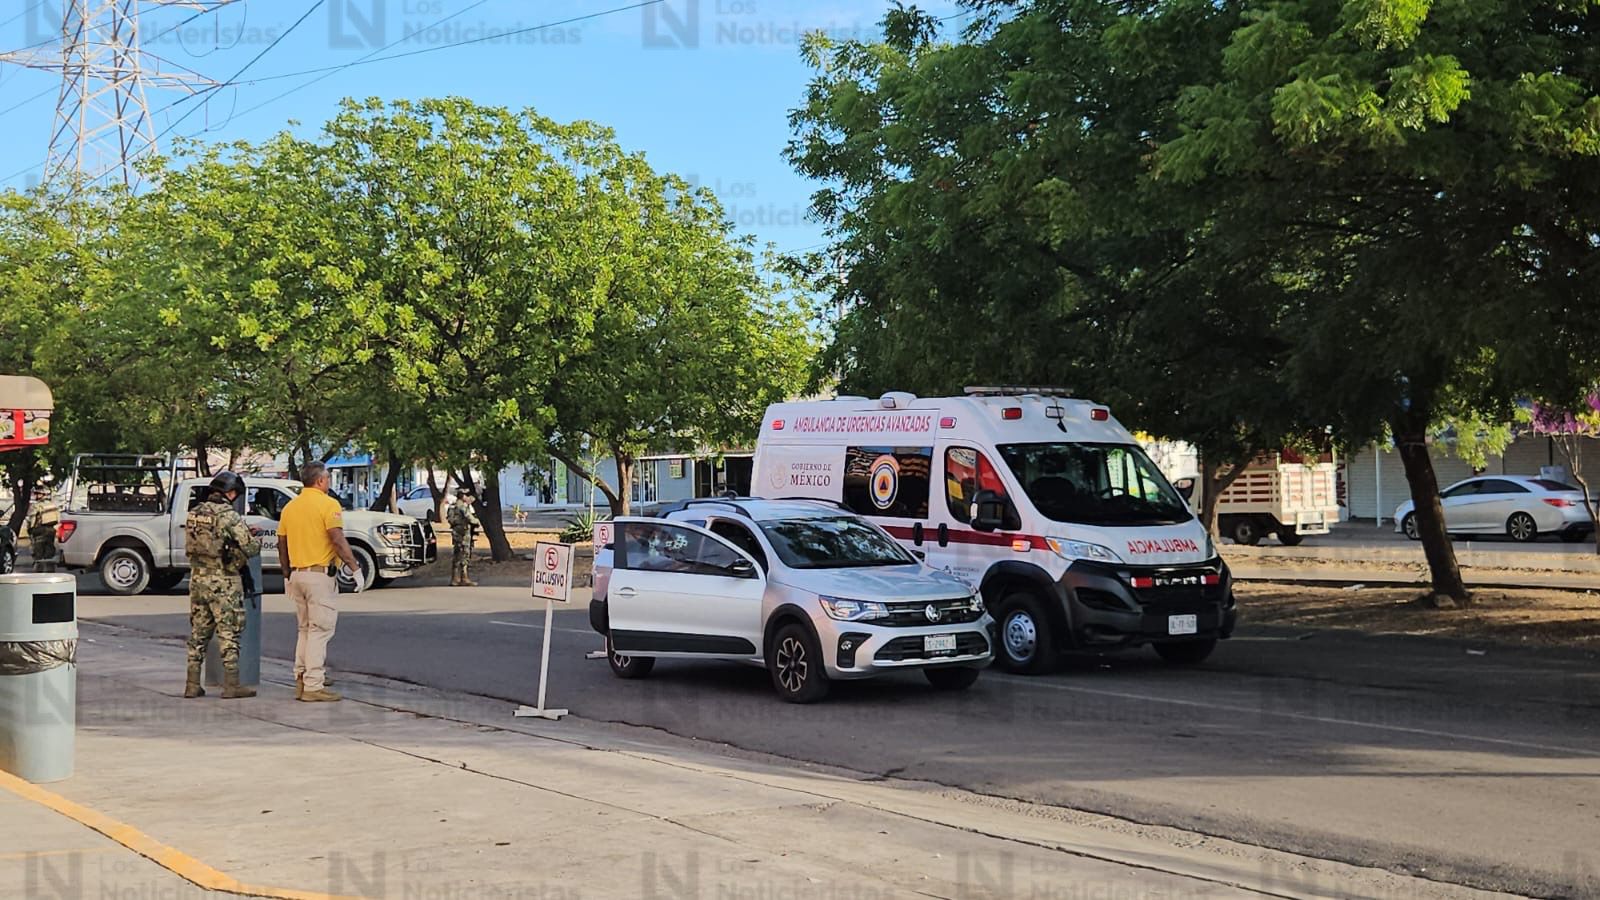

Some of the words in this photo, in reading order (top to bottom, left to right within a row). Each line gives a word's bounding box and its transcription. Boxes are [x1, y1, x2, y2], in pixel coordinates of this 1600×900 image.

[793, 416, 835, 432] AMBULANCIA
[836, 416, 846, 432] DE
[847, 415, 885, 432] URGENCIAS
[886, 415, 931, 432] AVANZADAS
[823, 463, 832, 471] DE
[790, 470, 831, 487] MÉXICO
[535, 570, 565, 587] EXCLUSIVO
